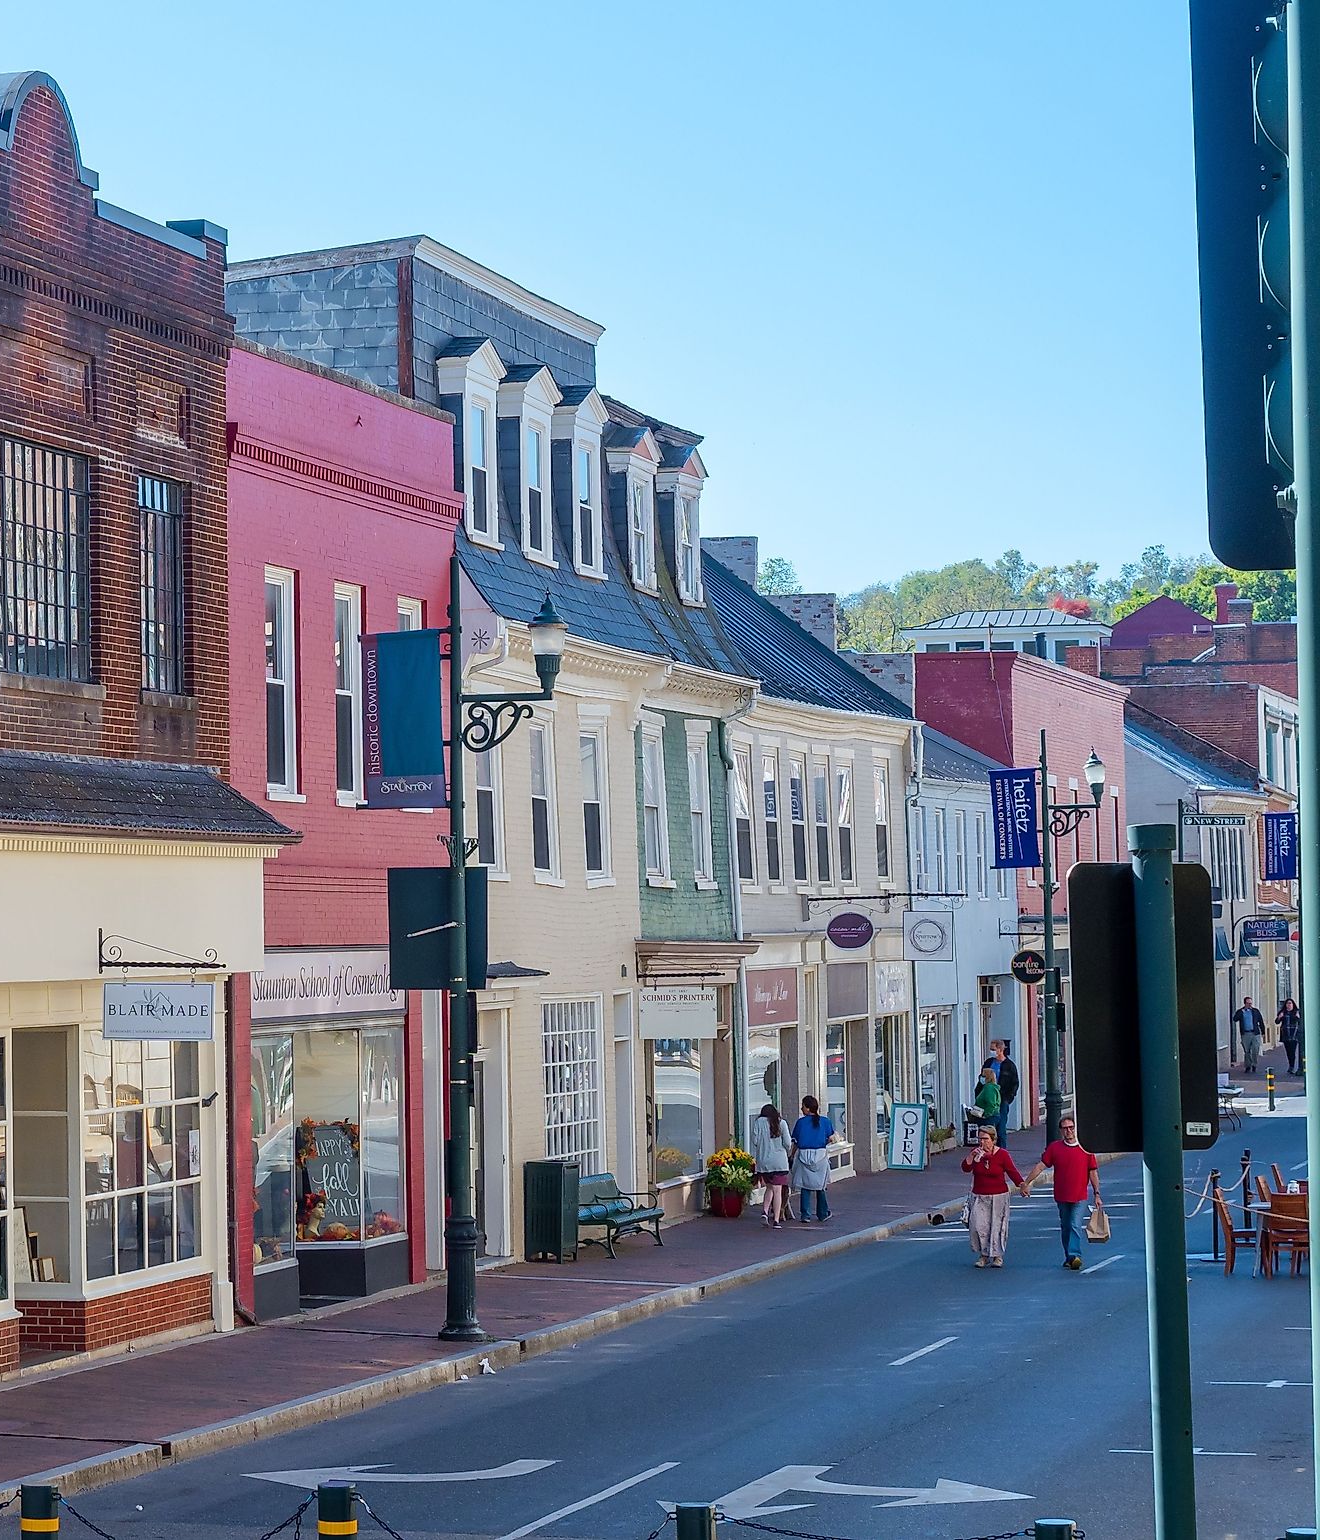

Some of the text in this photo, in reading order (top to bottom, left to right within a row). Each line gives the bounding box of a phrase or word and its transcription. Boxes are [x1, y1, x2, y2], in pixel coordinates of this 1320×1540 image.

[366, 649, 380, 775] historic downtown
[996, 779, 1007, 860] FESTIVAL OF CONCERTS
[1012, 777, 1031, 833] heifetz
[1280, 818, 1292, 857] heifetz
[1247, 921, 1286, 929] NATURE'S
[253, 971, 297, 1001] Staunton
[299, 965, 332, 998] School
[333, 965, 346, 1006] of
[642, 994, 715, 1002] SCHMID'S PRINTERY
[108, 1004, 209, 1017] BLAIR MADE
[902, 1110, 919, 1165] OPEN
[312, 1161, 358, 1199] fall
